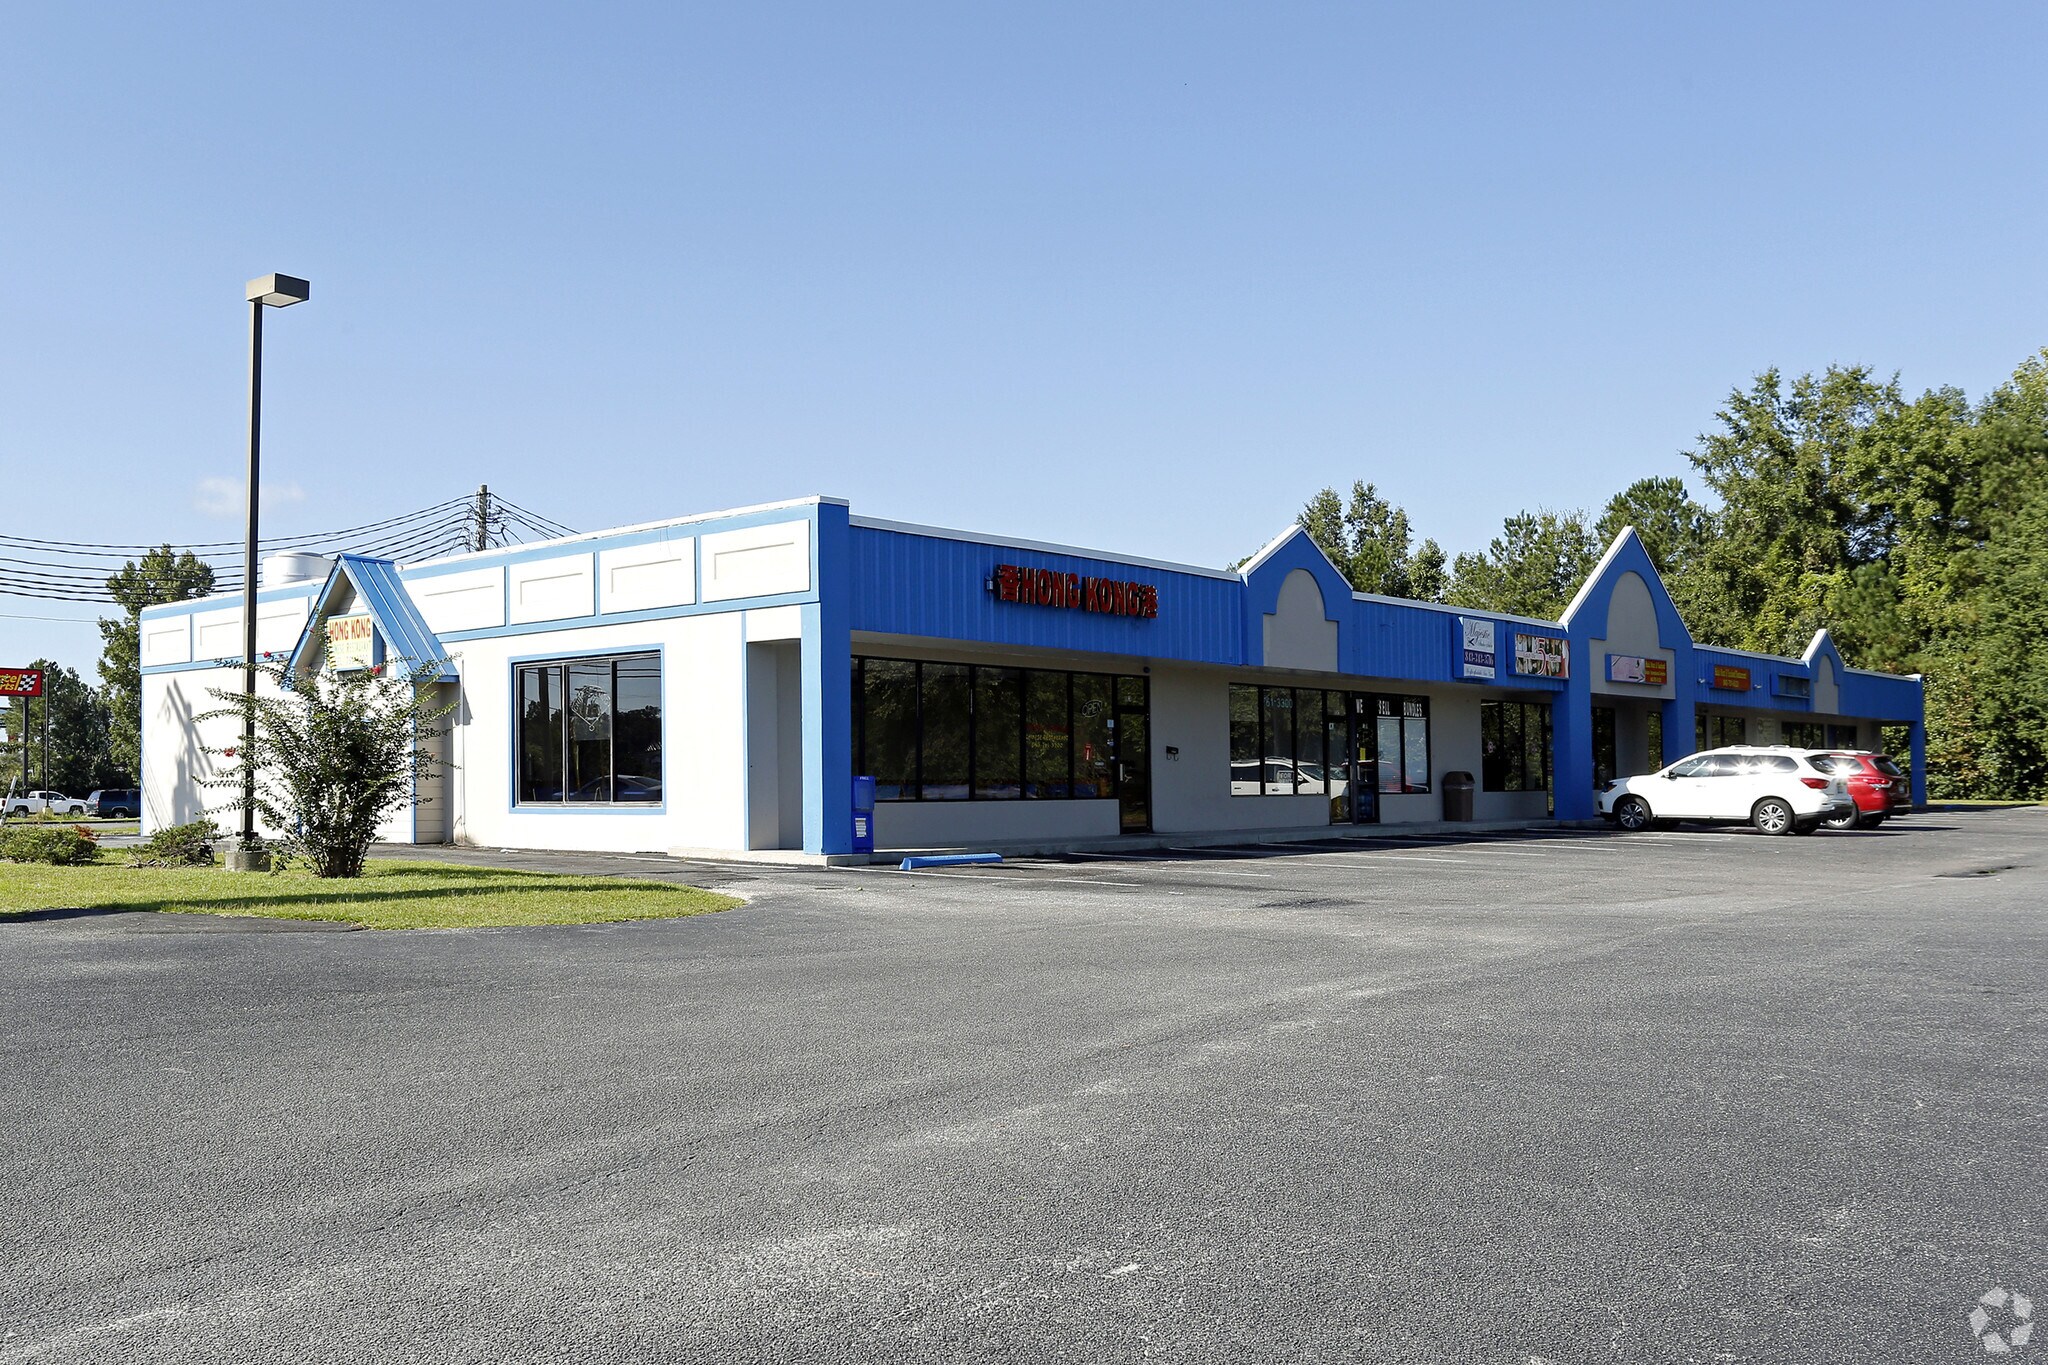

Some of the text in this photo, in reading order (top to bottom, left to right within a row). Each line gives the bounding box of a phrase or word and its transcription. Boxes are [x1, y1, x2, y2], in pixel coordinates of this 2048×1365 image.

[1022, 567, 1139, 616] HONG KONG
[329, 618, 370, 642] HONG KONG
[1082, 702, 1102, 715] OPEN
[1355, 698, 1422, 717] WE SELL BUNDLES
